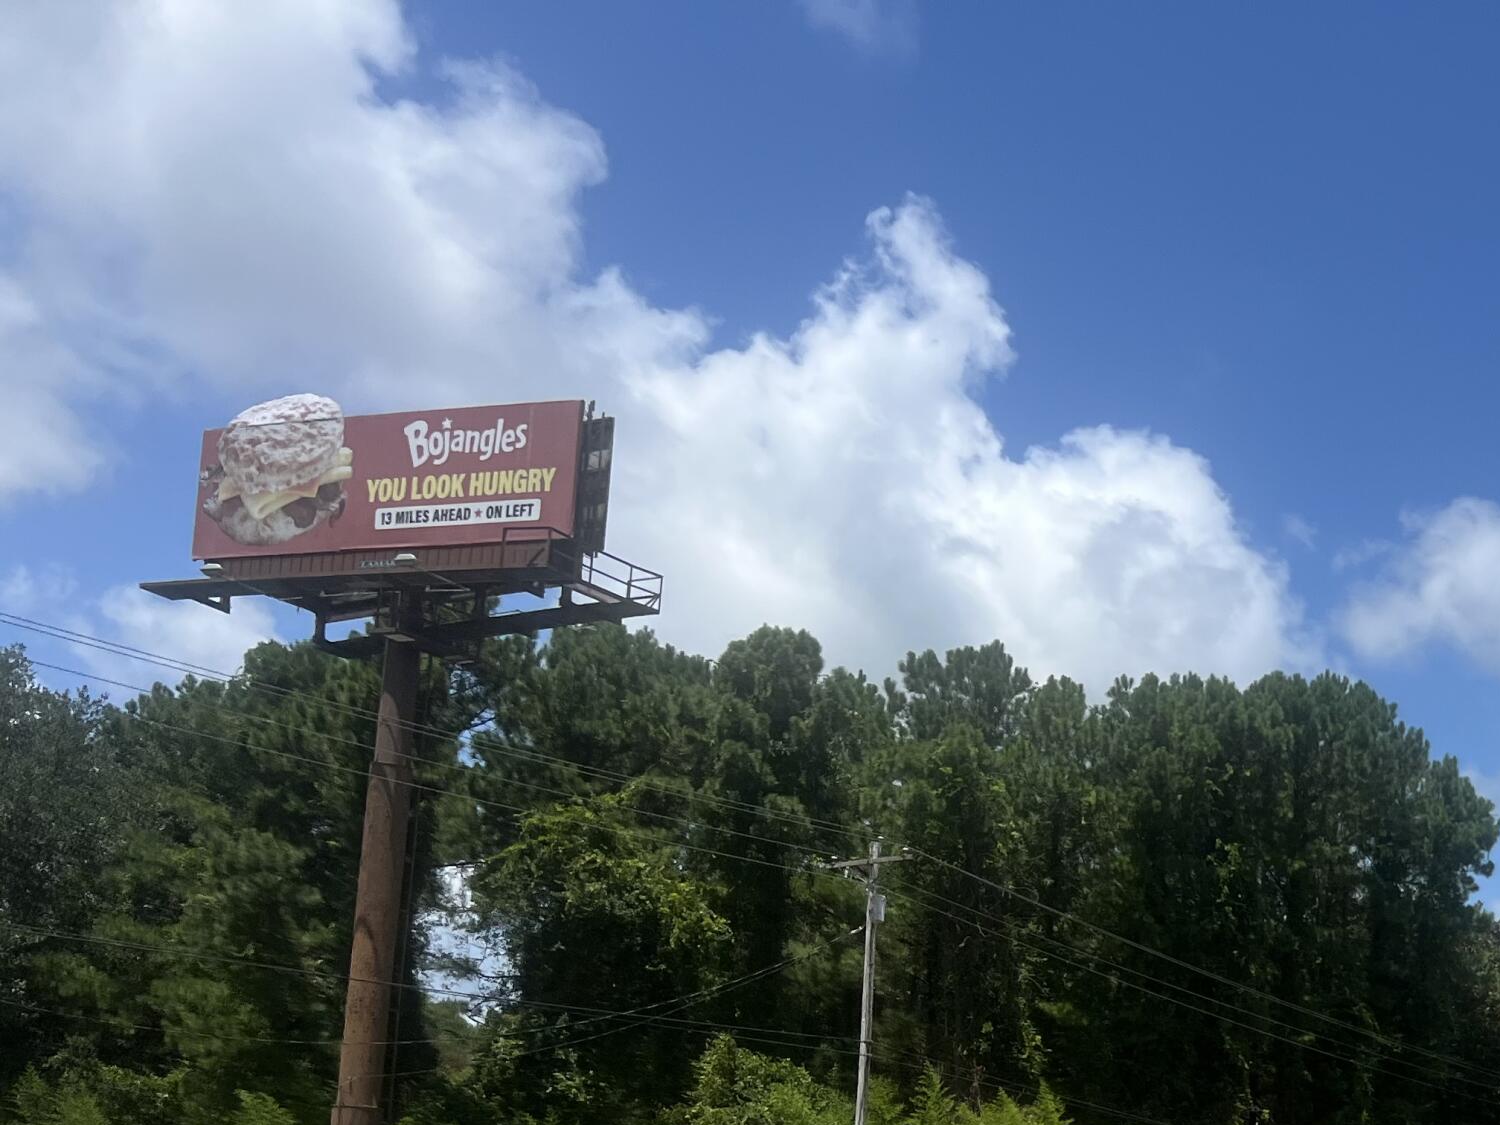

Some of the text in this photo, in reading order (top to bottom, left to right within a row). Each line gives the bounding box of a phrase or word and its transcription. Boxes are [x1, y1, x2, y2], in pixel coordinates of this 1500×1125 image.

[403, 418, 528, 468] Bojangles
[367, 467, 557, 503] YOU LOOK HUNGRY
[380, 503, 535, 526] 13 MILES AHEAD ON LEFT
